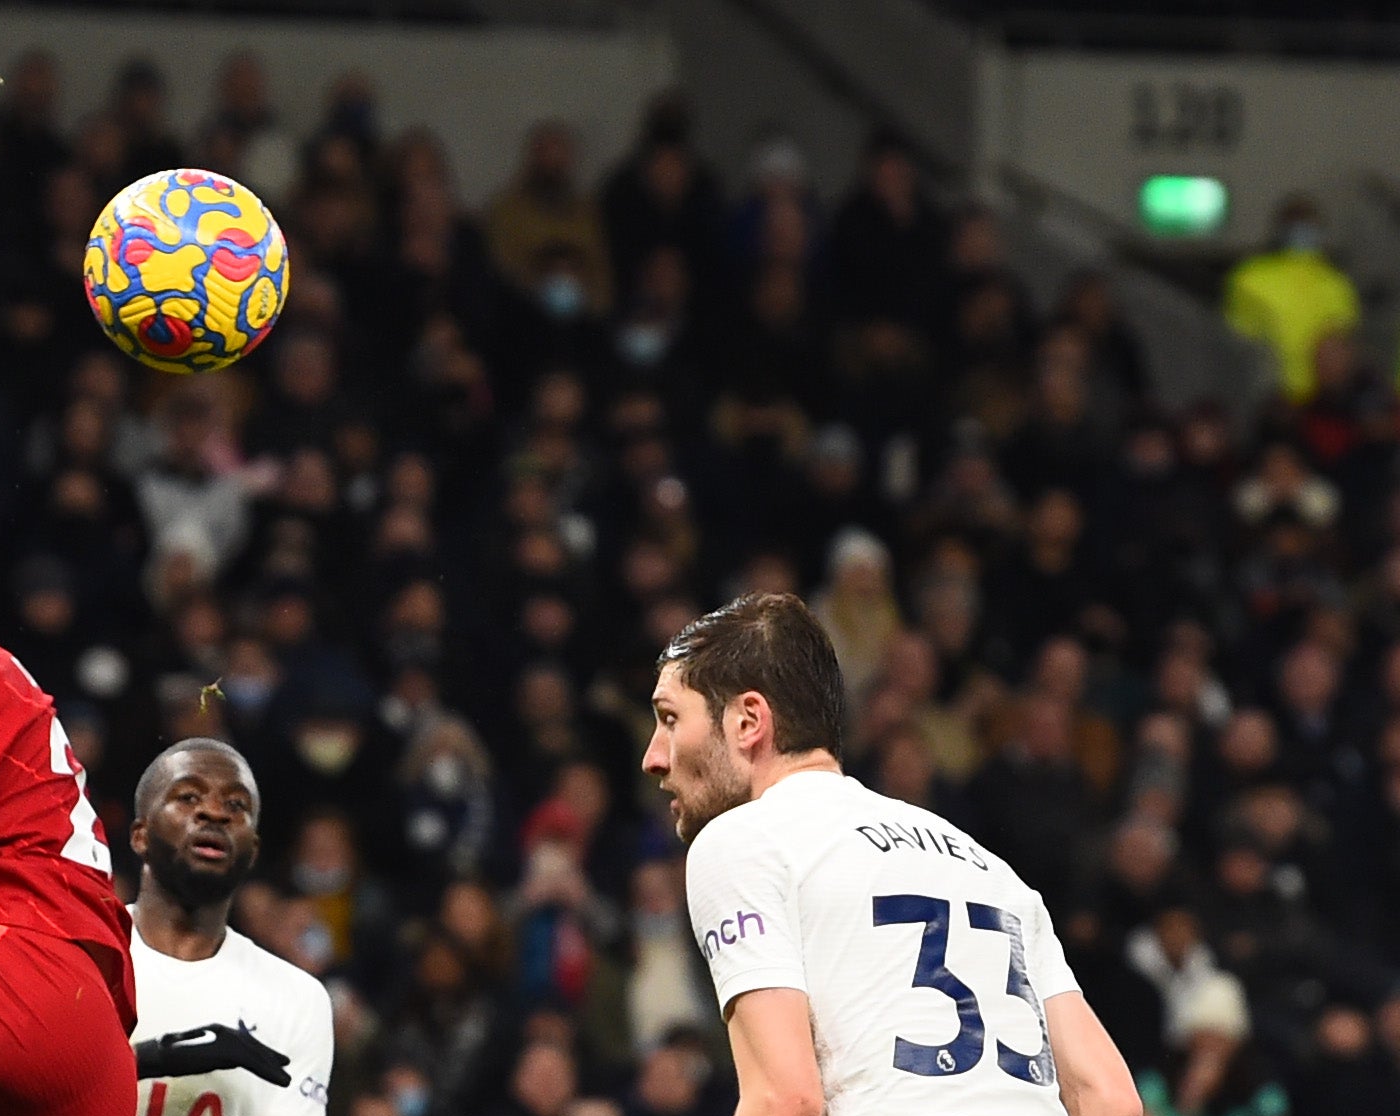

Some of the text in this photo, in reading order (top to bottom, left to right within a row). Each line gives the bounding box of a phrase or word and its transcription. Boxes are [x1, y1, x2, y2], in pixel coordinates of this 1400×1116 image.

[855, 821, 989, 872] DAVIES
[702, 910, 765, 960] nch
[872, 894, 1055, 1087] 33
